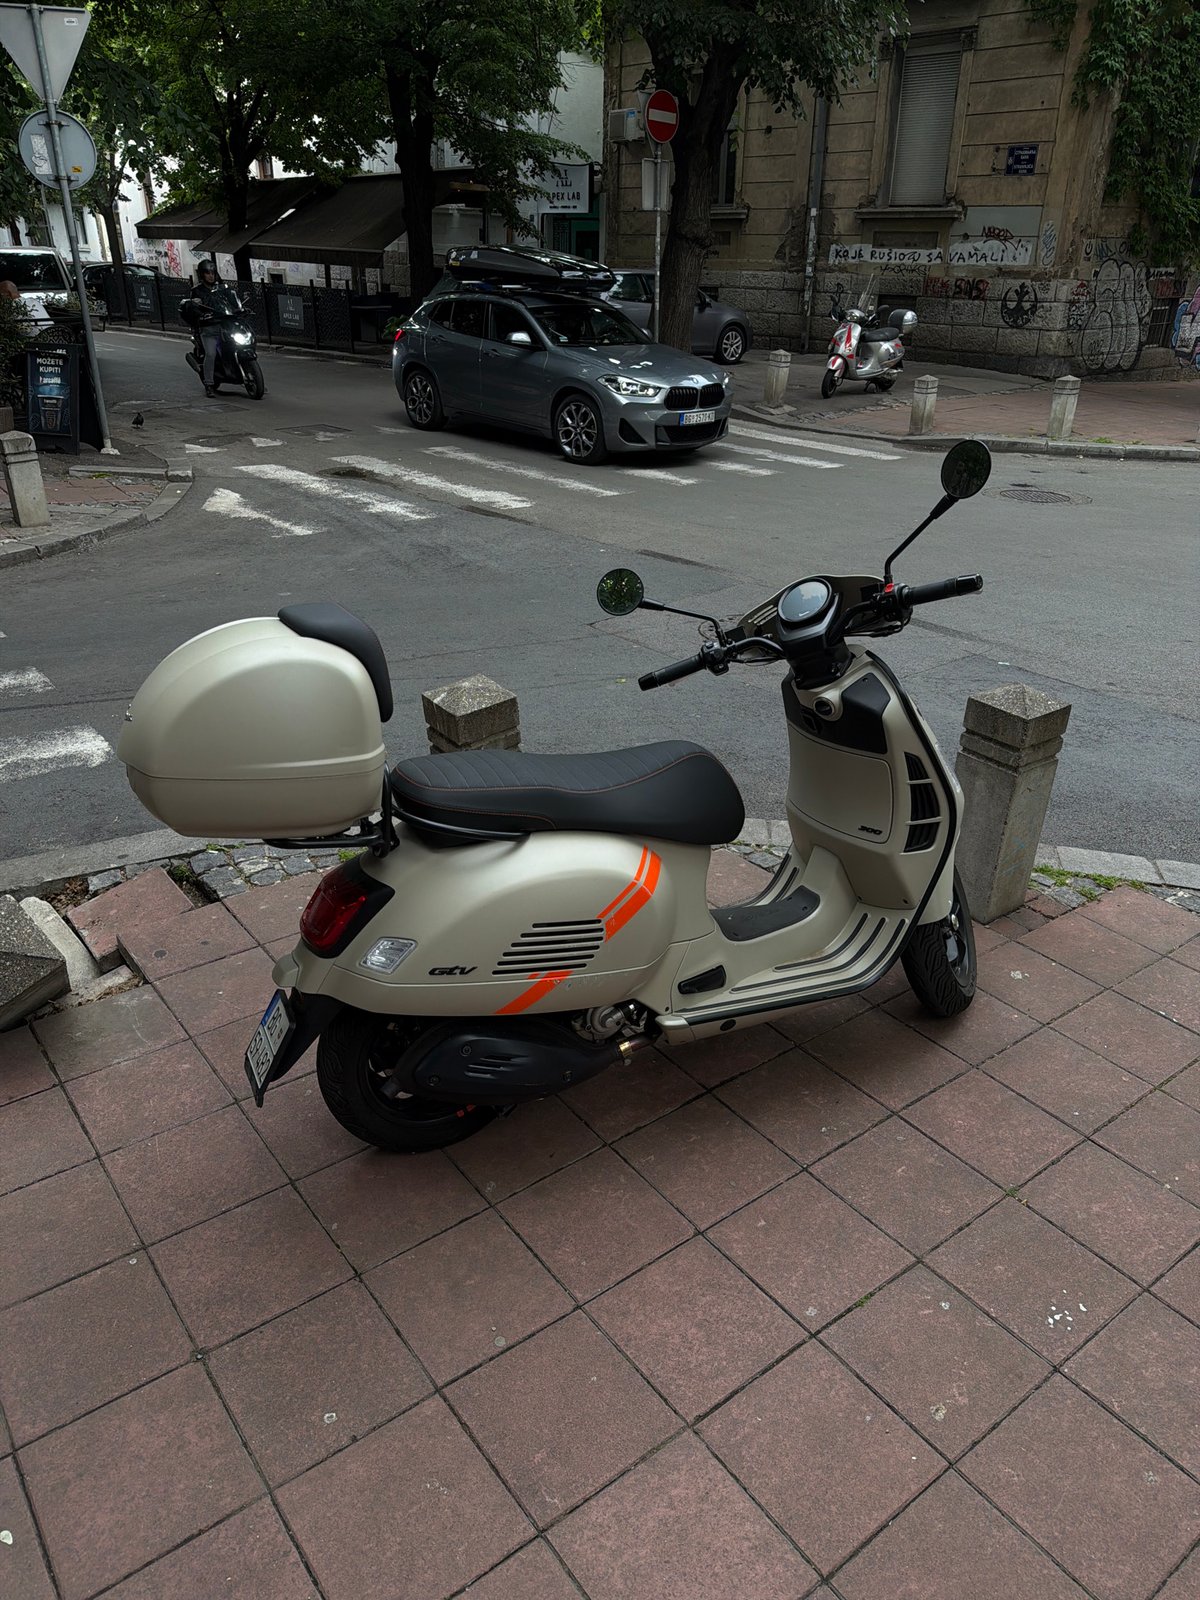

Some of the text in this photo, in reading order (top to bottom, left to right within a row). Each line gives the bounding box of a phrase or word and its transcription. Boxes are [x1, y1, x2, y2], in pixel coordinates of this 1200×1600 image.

[567, 191, 581, 200] LAB
[36, 357, 64, 366] MOŽETE
[39, 366, 61, 374] KUPITI
[267, 1006, 282, 1036] BG
